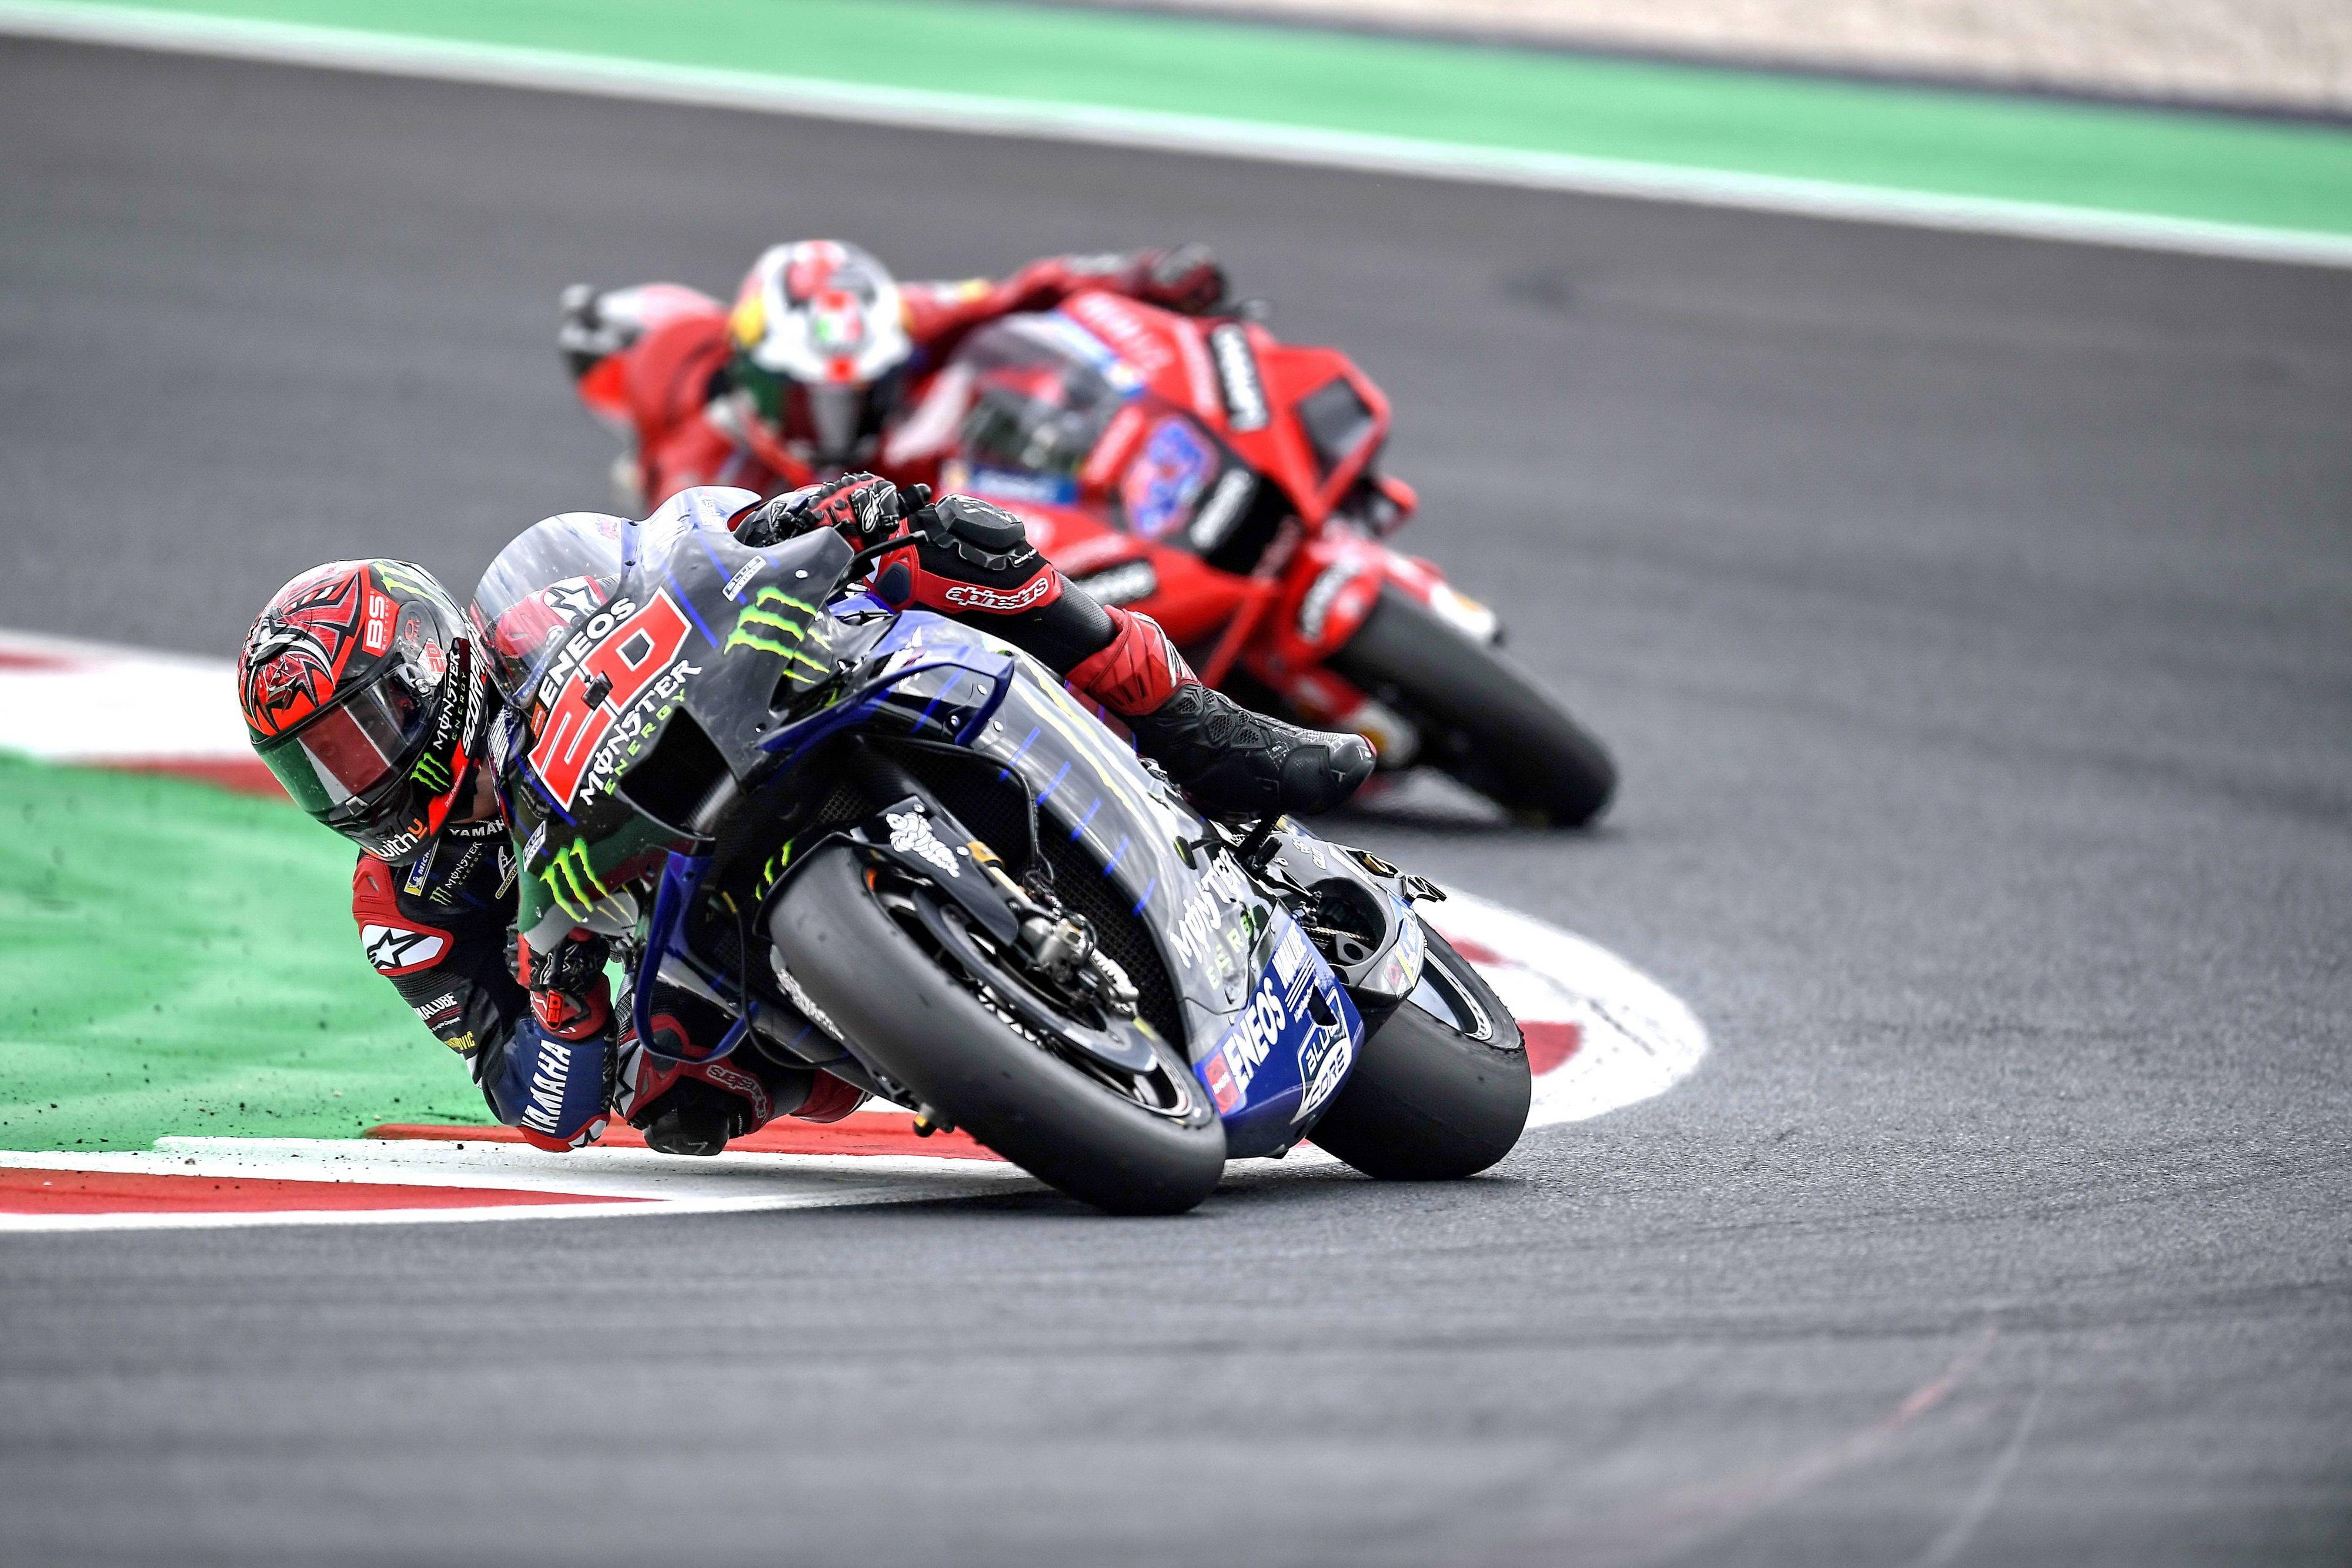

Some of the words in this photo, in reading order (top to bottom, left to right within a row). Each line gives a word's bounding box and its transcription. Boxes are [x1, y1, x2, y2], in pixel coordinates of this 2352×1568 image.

[366, 595, 385, 649] BS
[425, 643, 446, 673] 20
[538, 597, 637, 708] ENEOS
[433, 650, 460, 750] MONSTER
[451, 671, 466, 741] ENERGY
[527, 586, 693, 812] 20
[579, 659, 703, 806] MONSTER
[603, 688, 686, 795] ENERGY
[445, 841, 482, 888] MONSTER
[1222, 977, 1287, 1095] ENEOS
[521, 1039, 572, 1134] YAMAHA
